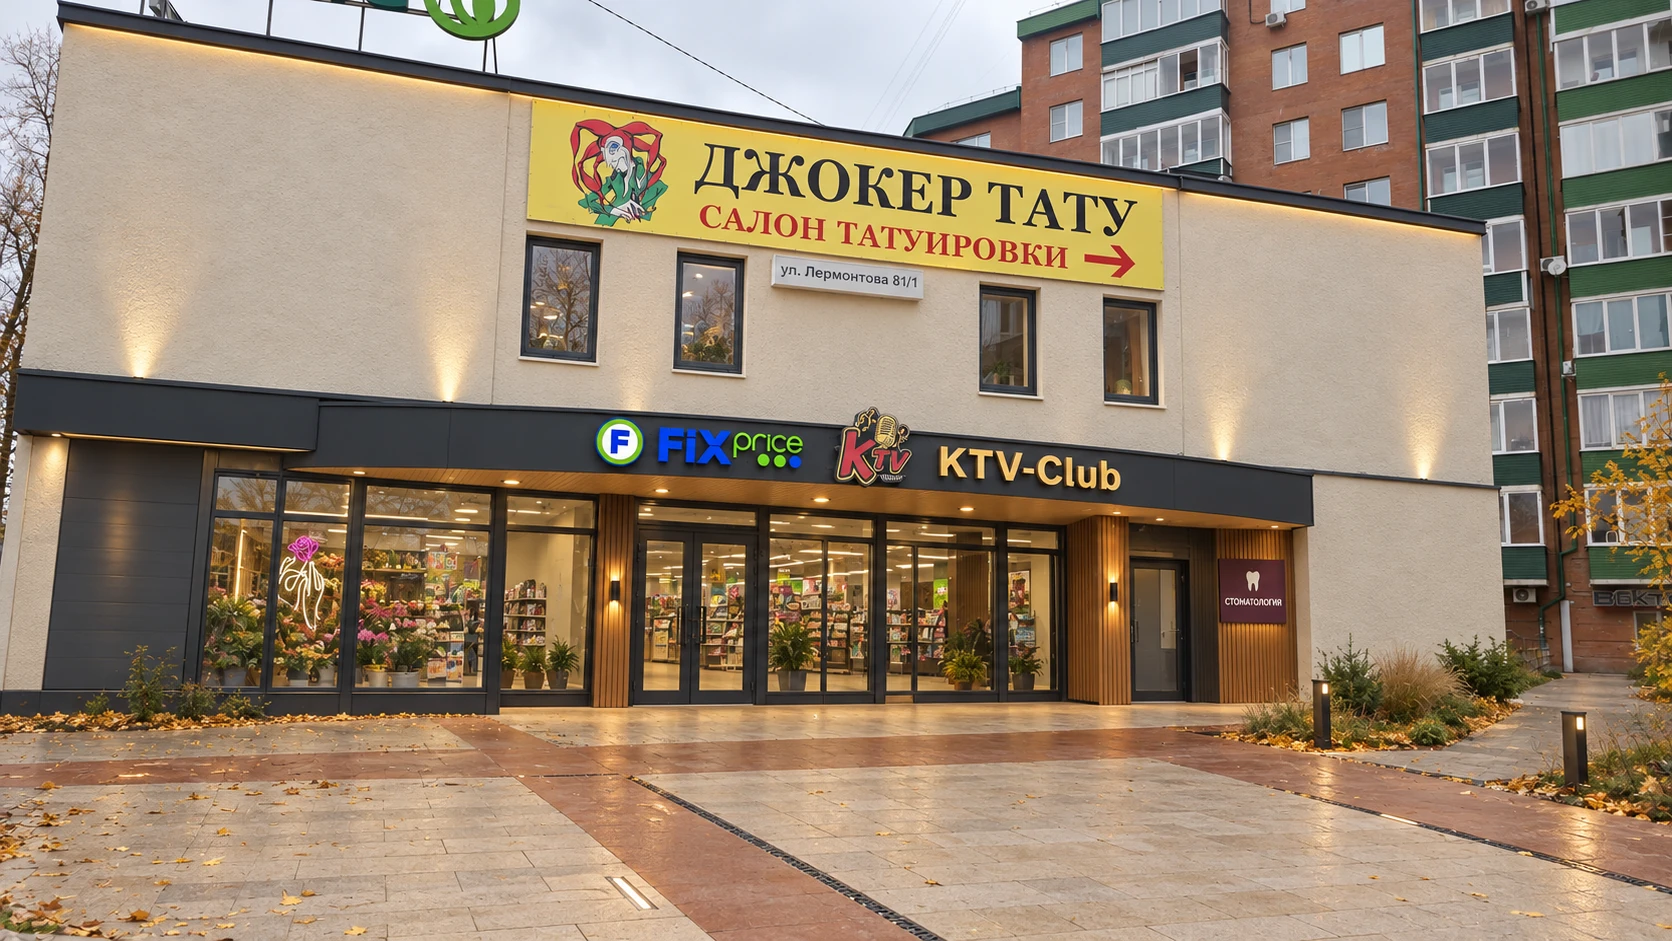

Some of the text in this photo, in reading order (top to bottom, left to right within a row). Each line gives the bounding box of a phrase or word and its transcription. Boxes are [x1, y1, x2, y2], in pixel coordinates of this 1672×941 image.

[694, 143, 1138, 237] ДЖОКЕР ТАТУ
[699, 204, 1069, 270] САЛОН ТАТУИРОВКИ
[780, 265, 918, 288] ул. Лермонтова 81/1
[939, 445, 1121, 491] KTV-Club
[1224, 597, 1282, 606] СТОМАТОЛОГИЯ
